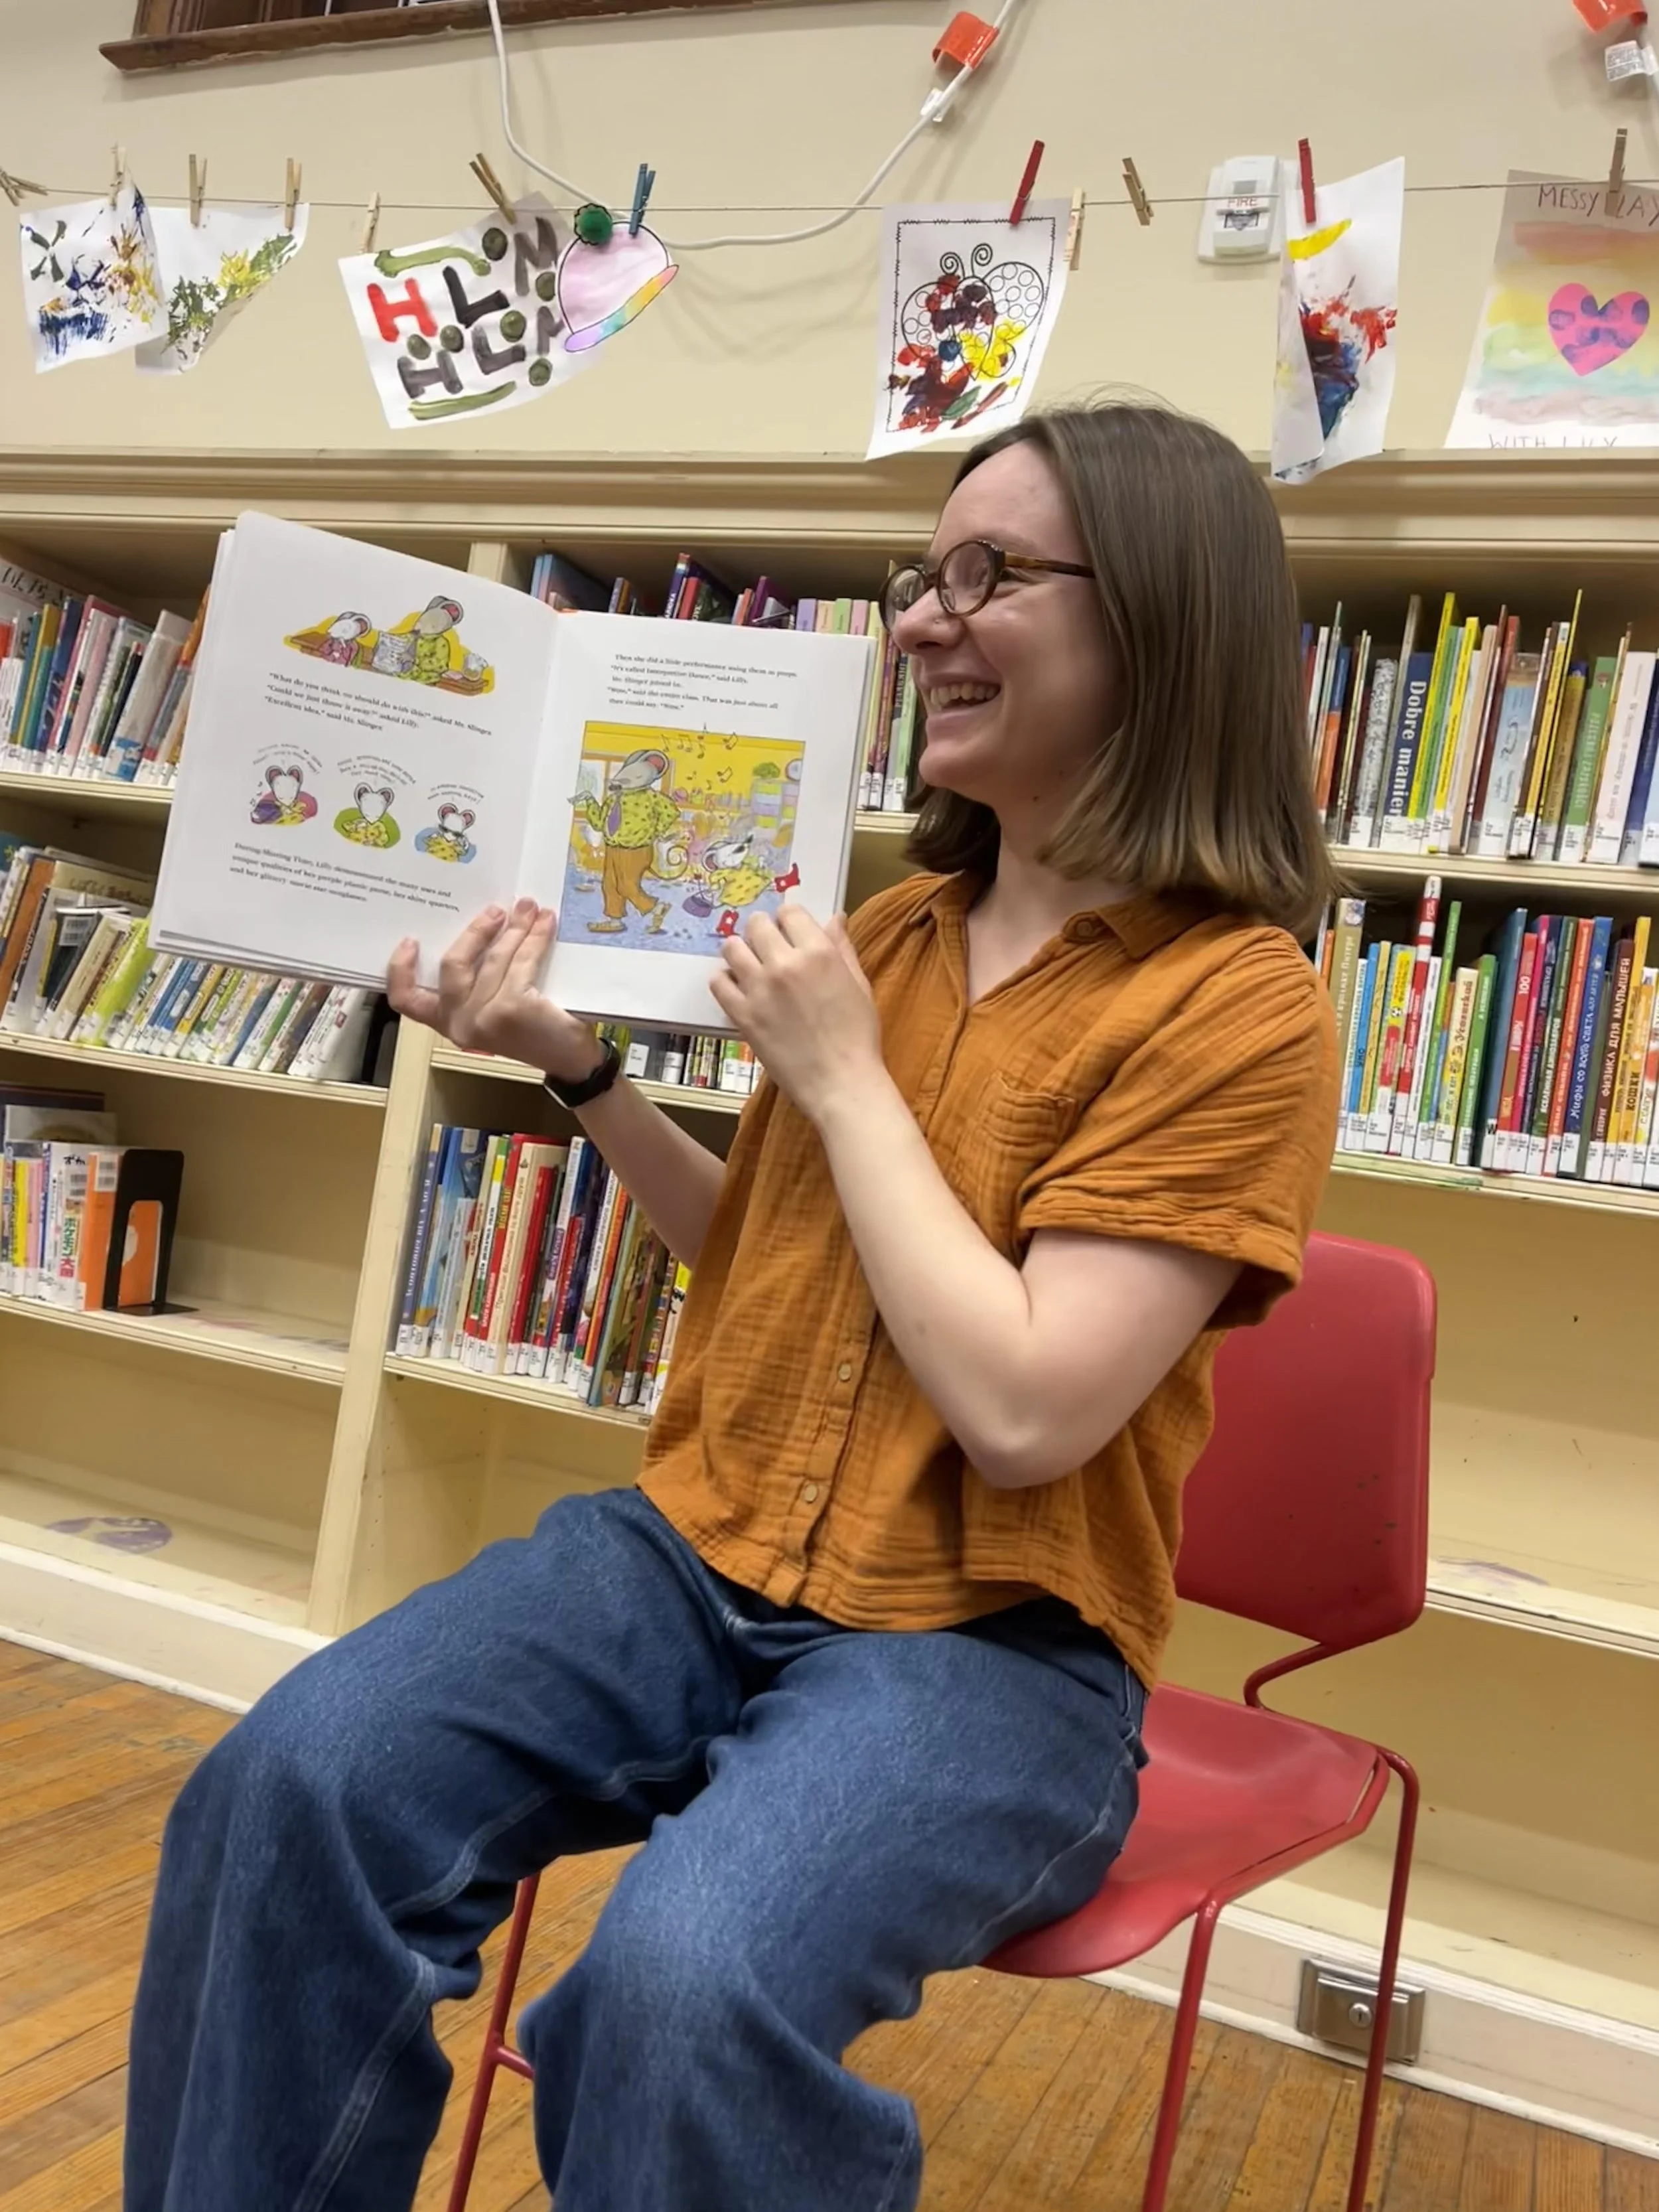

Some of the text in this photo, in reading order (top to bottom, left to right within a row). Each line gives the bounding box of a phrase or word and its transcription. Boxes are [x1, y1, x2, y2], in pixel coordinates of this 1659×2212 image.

[1228, 196, 1259, 208] FIRE
[1538, 184, 1659, 227] MESSY LAY
[1488, 433, 1547, 449] WITH
[1401, 678, 1427, 741] Dobre
[1518, 974, 1530, 995] 100
[1612, 957, 1631, 1019] МАЛЫШЕЙ
[1581, 1011, 1594, 1042] СВЕТА
[1607, 1022, 1621, 1048] ДЛЯ
[1576, 1069, 1585, 1082] СО
[1600, 1051, 1617, 1096] ФИЗИКА
[1569, 1084, 1584, 1119] Мифы
[1626, 1071, 1640, 1110] КОШКИ
